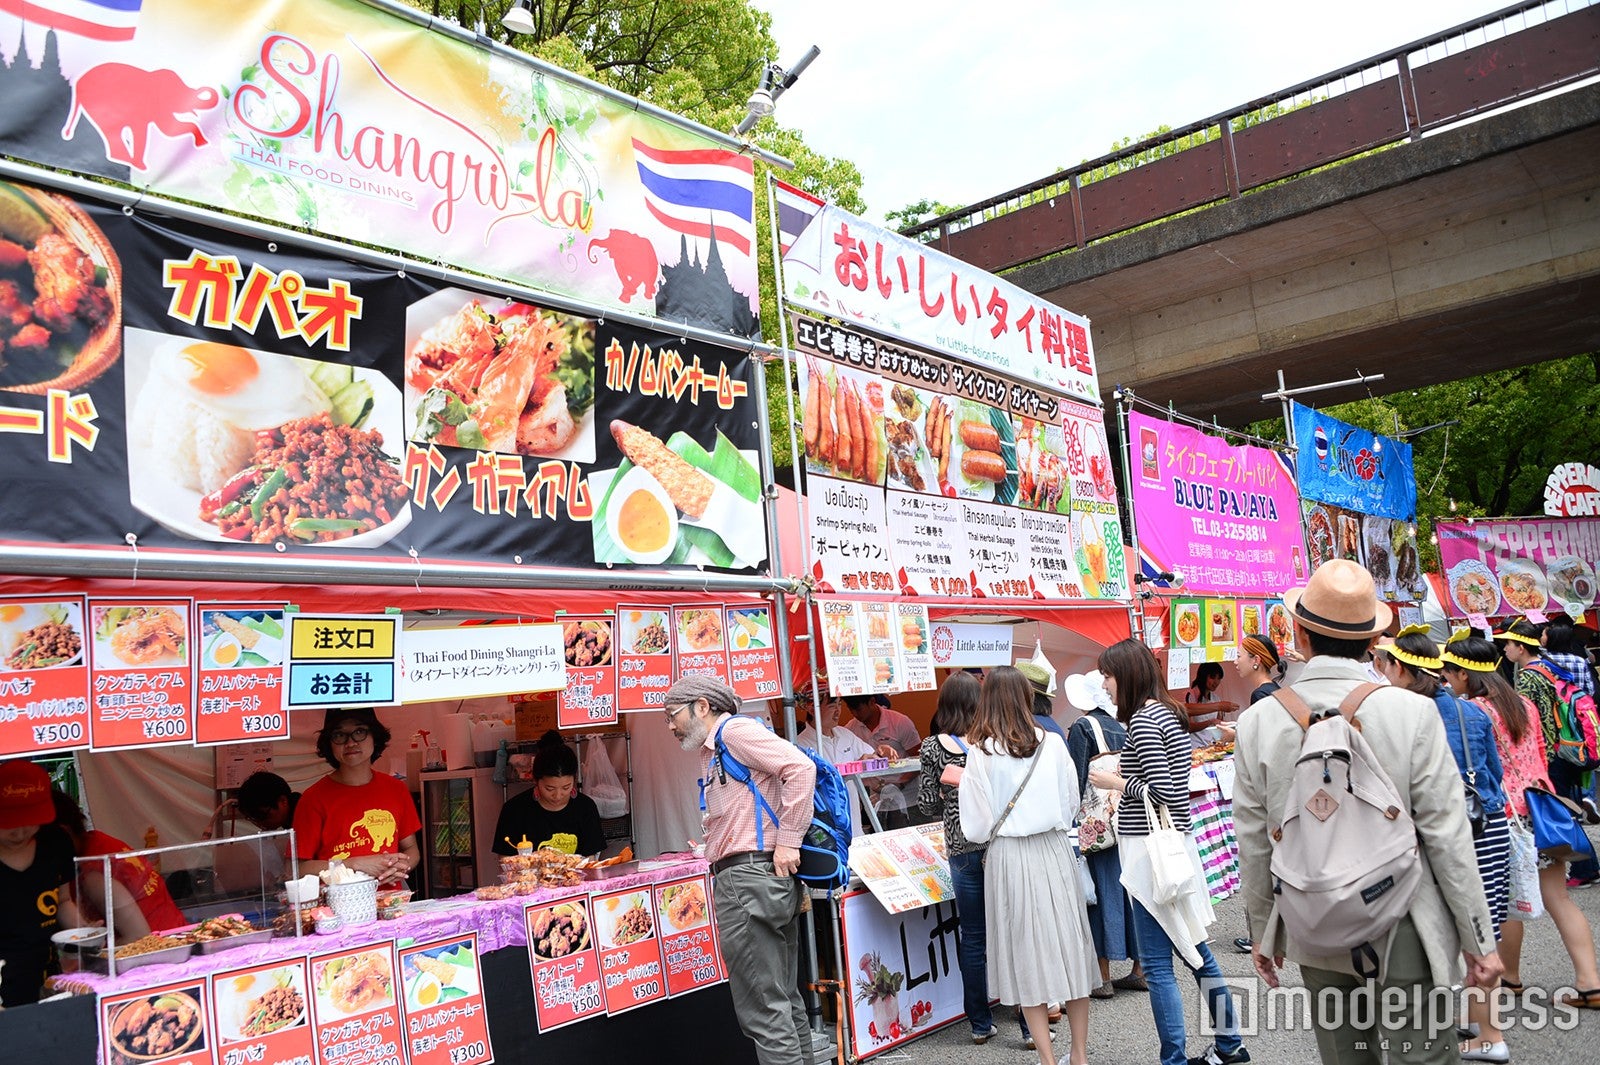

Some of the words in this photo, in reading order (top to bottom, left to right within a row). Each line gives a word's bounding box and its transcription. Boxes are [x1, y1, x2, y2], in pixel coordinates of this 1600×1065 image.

[233, 33, 593, 236] Shangri-la
[236, 140, 283, 167] THAI
[288, 159, 343, 185] FOOD
[349, 173, 414, 203] DINING
[163, 249, 363, 351] ガパオ
[833, 222, 1094, 376] おいしいタイ料理
[605, 337, 748, 409] カノムパンナームー
[798, 320, 877, 372] エビ春巻き
[878, 347, 949, 383] おすすめセット
[951, 366, 1007, 404] サイクロク
[1010, 388, 1060, 420] ガイヤーン
[0, 388, 100, 464] ード
[402, 441, 462, 512] クン
[466, 451, 594, 521] ガティアム
[901, 497, 948, 511] タイ風ソーセージ
[1173, 476, 1214, 513] BLUE
[816, 516, 839, 531] Shrimp
[840, 520, 861, 534] Spring
[862, 523, 877, 533] Rolls
[915, 525, 943, 537] エビ春巻き
[968, 532, 978, 540] Thai
[979, 535, 996, 543] Herbal
[996, 536, 1015, 547] Sausage
[916, 554, 951, 565] タイ風焼き鶏
[978, 562, 1009, 574] ソーセージ
[1030, 557, 1067, 571] タイ風焼き鶏
[824, 602, 853, 614] ガイヤーン
[313, 627, 374, 650] 注文口
[936, 639, 950, 650] RIO
[956, 640, 975, 651] Little
[978, 641, 994, 651] Asian
[995, 641, 1009, 651] Food
[413, 650, 438, 664] Thai
[441, 650, 468, 662] Food
[470, 648, 504, 662] Dining
[620, 659, 646, 672] ガパオ
[0, 677, 36, 697] パオ
[96, 673, 185, 691] クンガティアム
[202, 674, 283, 691] カノムパンナームー
[310, 672, 372, 695] お会計
[756, 681, 778, 693] ¥300
[98, 692, 168, 707] 有頭エビの
[201, 697, 261, 715] 海老トースト
[101, 705, 185, 722] ニンニク炒め
[588, 705, 612, 720] ¥500
[32, 722, 82, 744] ¥500
[143, 718, 186, 737] ¥600
[243, 715, 282, 732] ¥300
[603, 951, 629, 970] ガパオ
[667, 947, 703, 964] 有頭エビの
[537, 958, 584, 983] ガイトード
[670, 956, 713, 975] ニンニク炒め
[693, 965, 717, 983] ¥600
[633, 981, 659, 1000] ¥500
[572, 994, 601, 1014] ¥500
[410, 1002, 481, 1033] カノムパンナームー
[320, 1012, 394, 1044] クンガティアム
[324, 1034, 382, 1059] 有頭エビの
[412, 1027, 464, 1056] 海老トースト
[450, 1042, 485, 1065] ¥300
